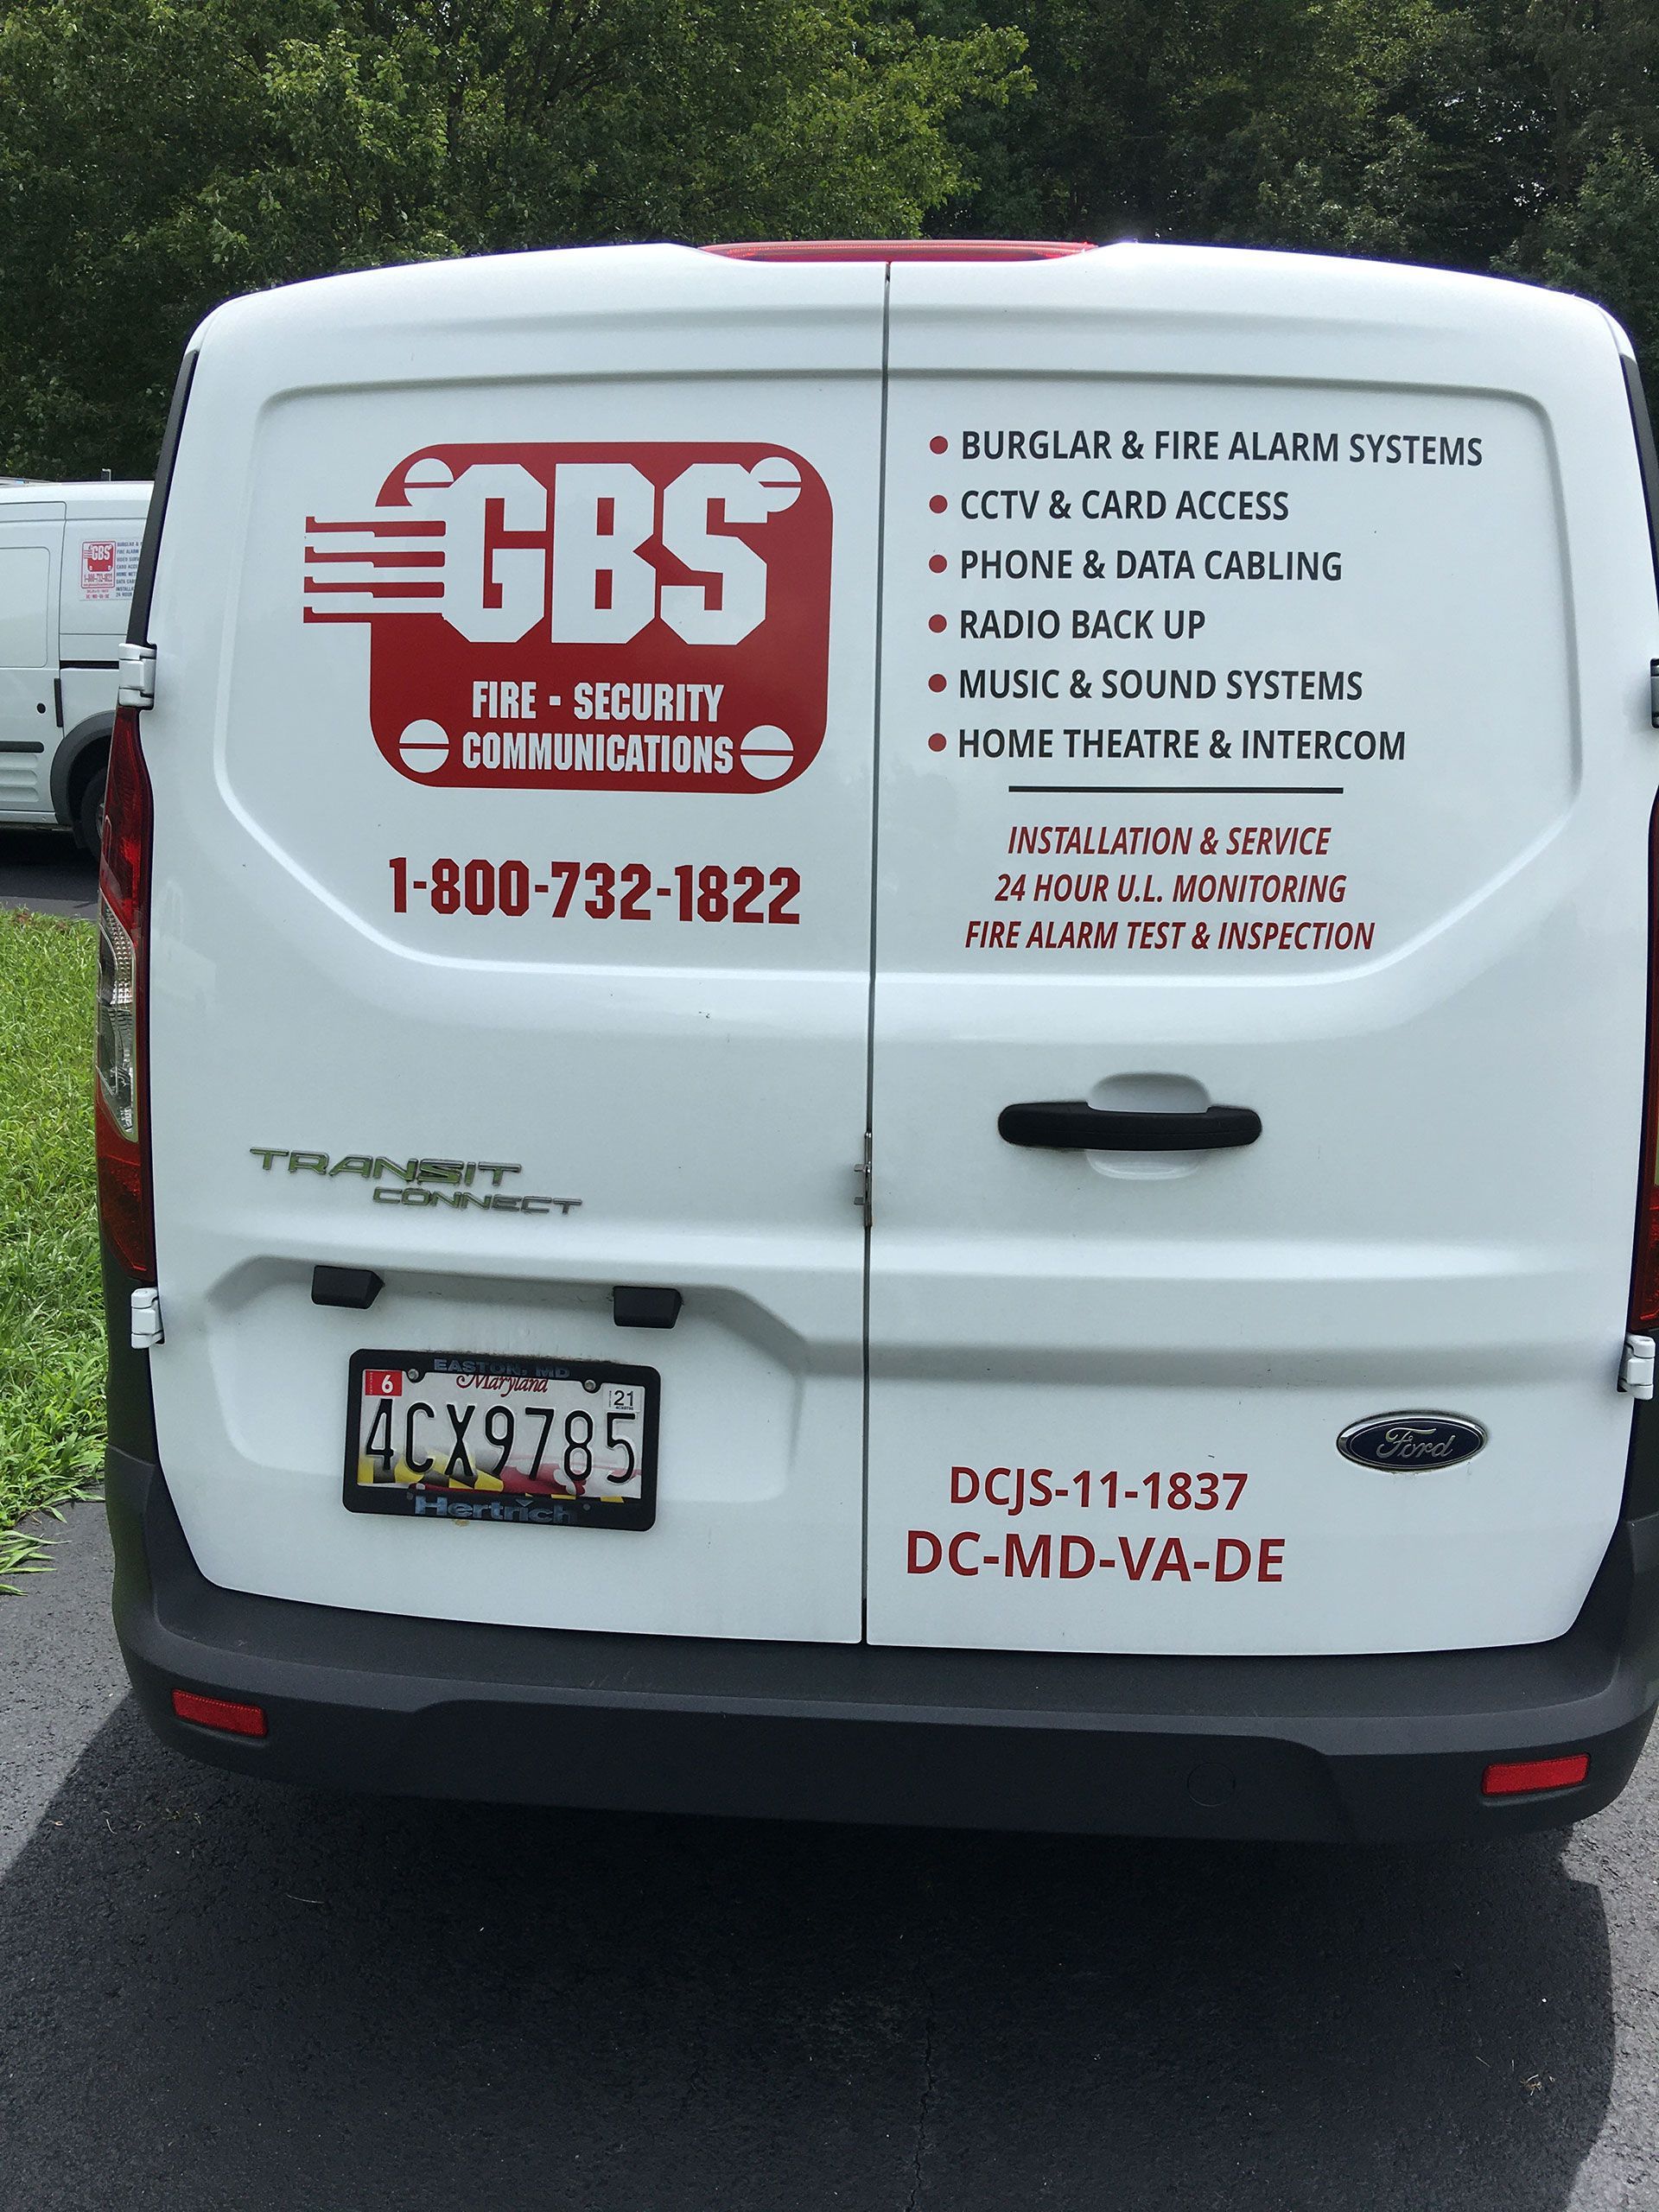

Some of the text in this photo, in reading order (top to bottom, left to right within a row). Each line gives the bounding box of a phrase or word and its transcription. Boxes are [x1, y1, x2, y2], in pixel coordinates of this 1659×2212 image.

[963, 430, 1482, 466] BURGLAR & FIRE ALARM SYSTEMS
[962, 490, 1288, 520] CCTV & CARD ACCESS
[92, 544, 111, 560] GBS
[443, 463, 768, 645] GBS
[962, 550, 1341, 581] PHONE & DATA CABLING
[961, 610, 1205, 639] RADIO BACK UP
[961, 670, 1362, 700] MUSIC & SOUND SYSTEMS
[473, 682, 724, 721] FIRE - SECURITY
[463, 732, 733, 773] COMMUNICATIONS
[960, 729, 1404, 760] HOME THEATRE & INTERCOM
[1008, 827, 1332, 855] INSTALLATION & SERVICE
[390, 857, 800, 924] 1-800-732-1822
[995, 874, 1346, 902] 24 HOUR U.L. MONITORING
[966, 921, 1375, 950] FIRE ALARM TEST & INSPECTION
[250, 1147, 522, 1186] TRANSIT
[372, 1186, 582, 1214] CONNECT
[434, 1358, 570, 1379] EASTON, MD
[382, 1375, 393, 1393] 6
[456, 1373, 549, 1397] Maryland
[613, 1390, 633, 1406] 21
[365, 1398, 636, 1484] 4CX9785
[1376, 1427, 1456, 1459] Ford
[951, 1466, 1248, 1516] DCJS-11-1837
[414, 1496, 576, 1523] Hertrich
[907, 1530, 1285, 1581] DC-MD-VA-DE
